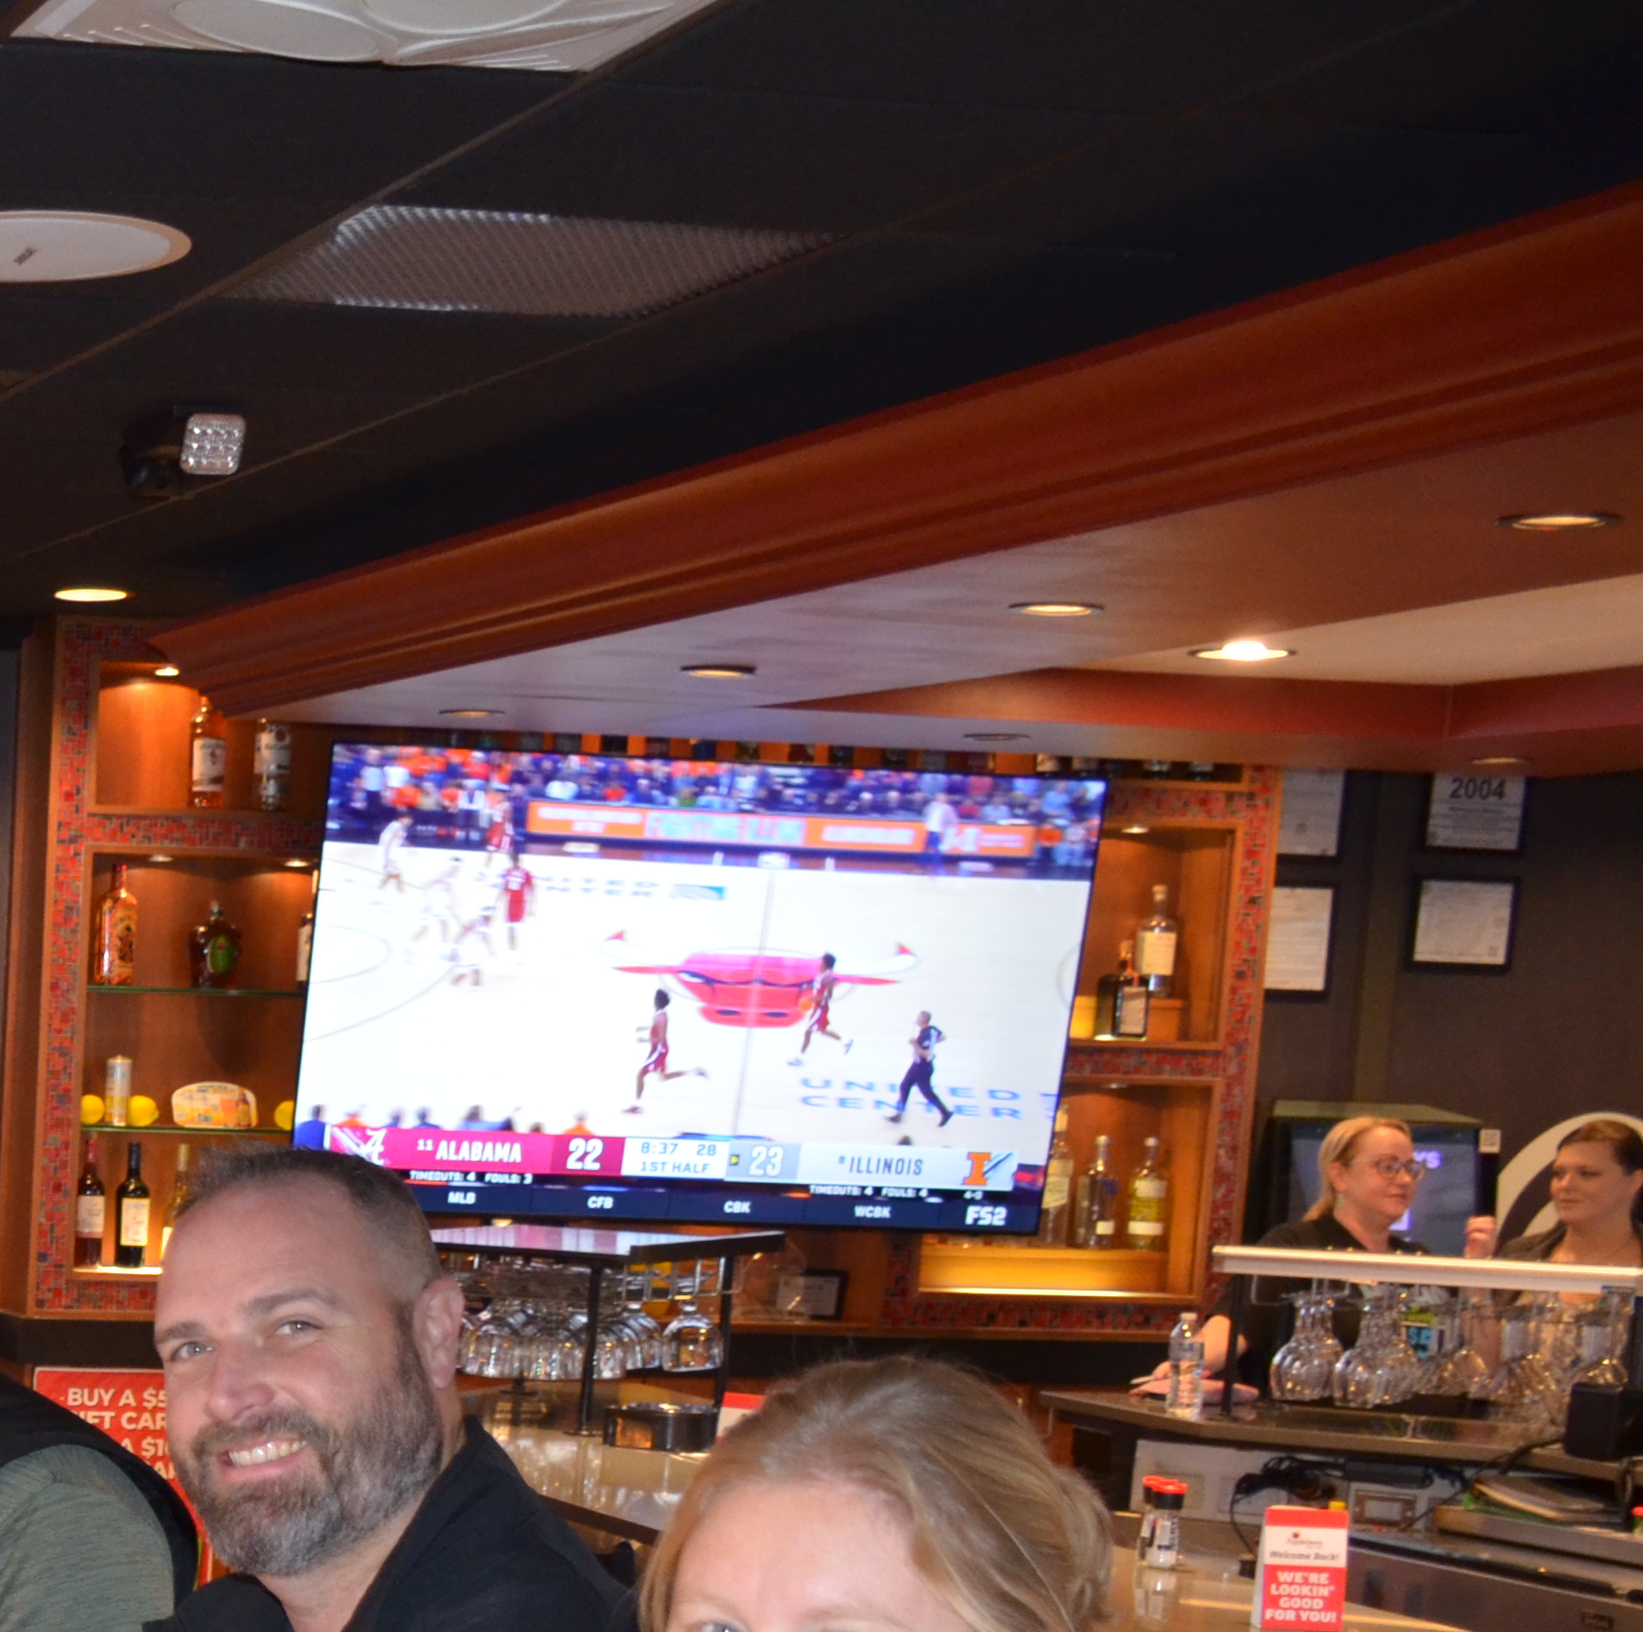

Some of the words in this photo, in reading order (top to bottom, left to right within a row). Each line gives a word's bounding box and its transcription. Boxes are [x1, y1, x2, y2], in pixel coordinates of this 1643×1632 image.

[1449, 776, 1507, 801] 2004
[436, 1140, 522, 1164] ALABAMA
[566, 1138, 604, 1171] 22
[640, 1141, 679, 1156] 8:37
[696, 1143, 718, 1156] 28
[748, 1145, 784, 1176] 23
[849, 1156, 924, 1176] ILLINOIS
[640, 1161, 667, 1173] 1ST
[670, 1161, 711, 1174] HALF
[447, 1191, 476, 1205] MLB
[587, 1196, 614, 1209] CFB
[965, 1206, 1008, 1226] FS2
[67, 1388, 115, 1407] BUY
[119, 1388, 137, 1407] A
[1277, 1571, 1330, 1584] WE'RE
[1270, 1584, 1334, 1597] LOOKIN'
[1279, 1597, 1324, 1610] GOOD
[1264, 1609, 1297, 1621] FOR
[1300, 1610, 1337, 1623] YOU!
